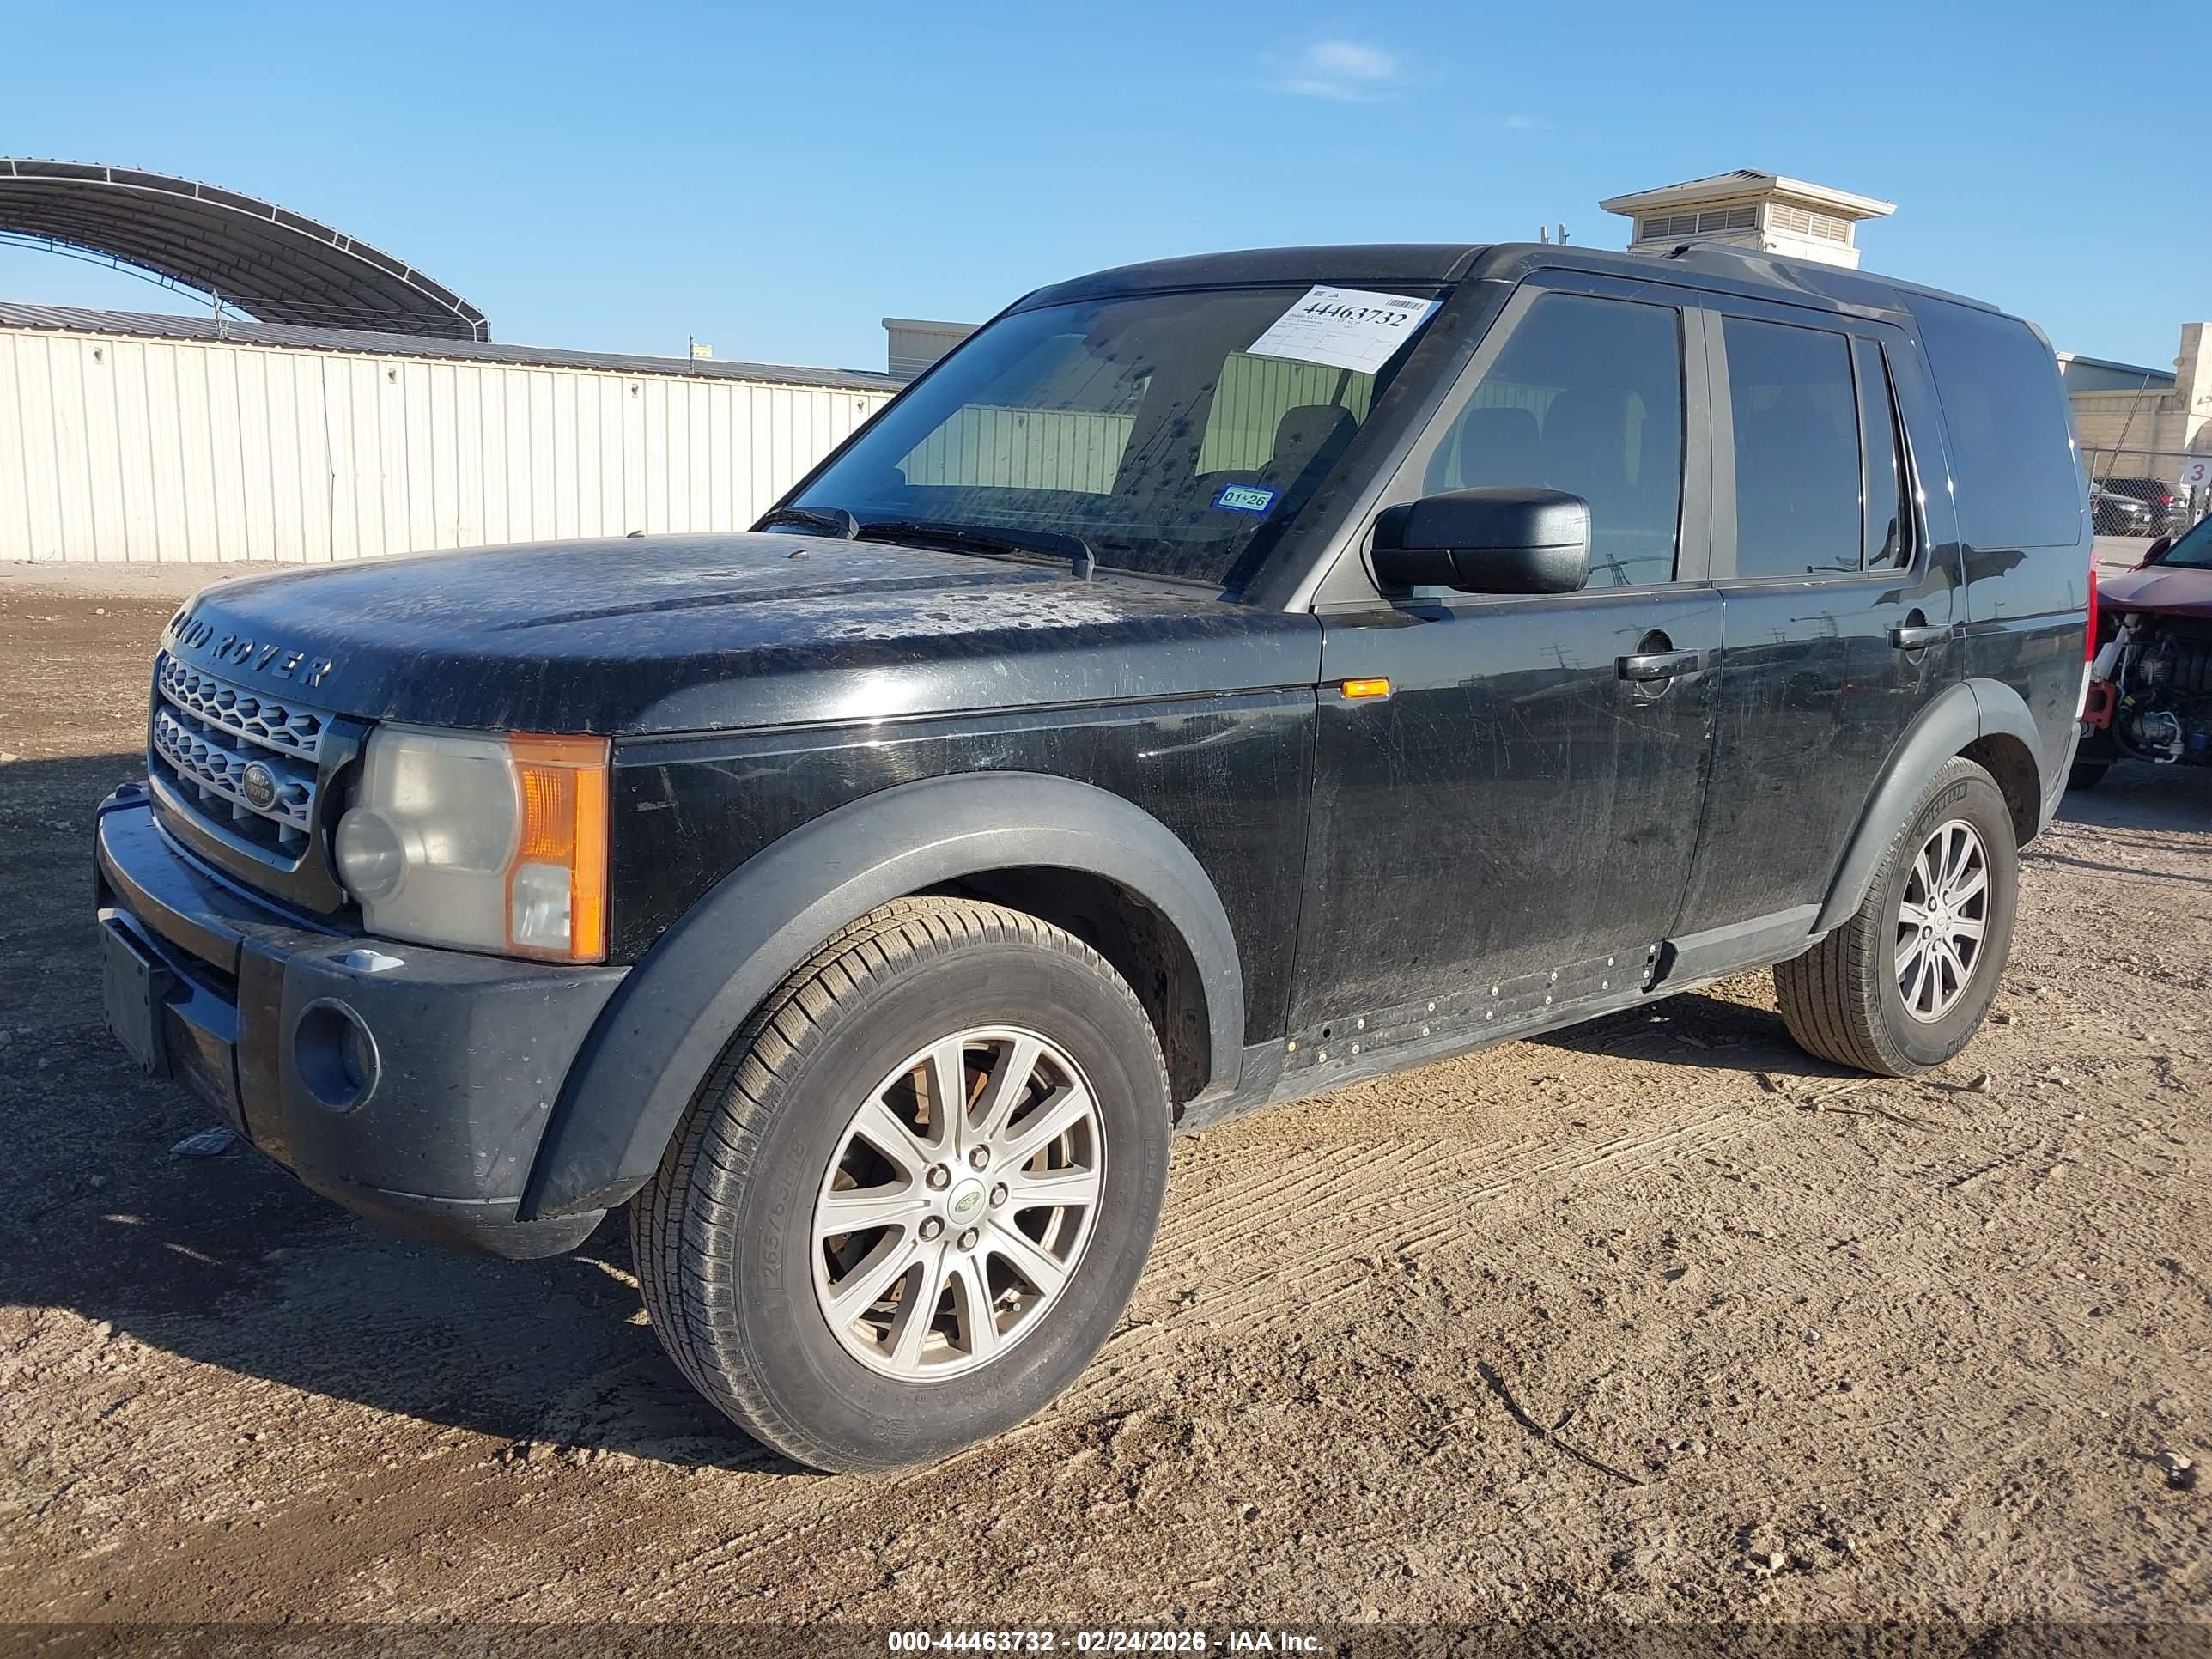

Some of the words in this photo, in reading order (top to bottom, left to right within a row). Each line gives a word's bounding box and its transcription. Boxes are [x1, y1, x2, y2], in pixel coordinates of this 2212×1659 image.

[1303, 301, 1408, 327] 44463732
[2190, 464, 2205, 481] 3
[1224, 492, 1242, 502] 01
[1248, 495, 1267, 507] 26
[210, 632, 332, 688] ROVER
[249, 770, 265, 786] LAND
[1921, 782, 1966, 832] MICHELIN
